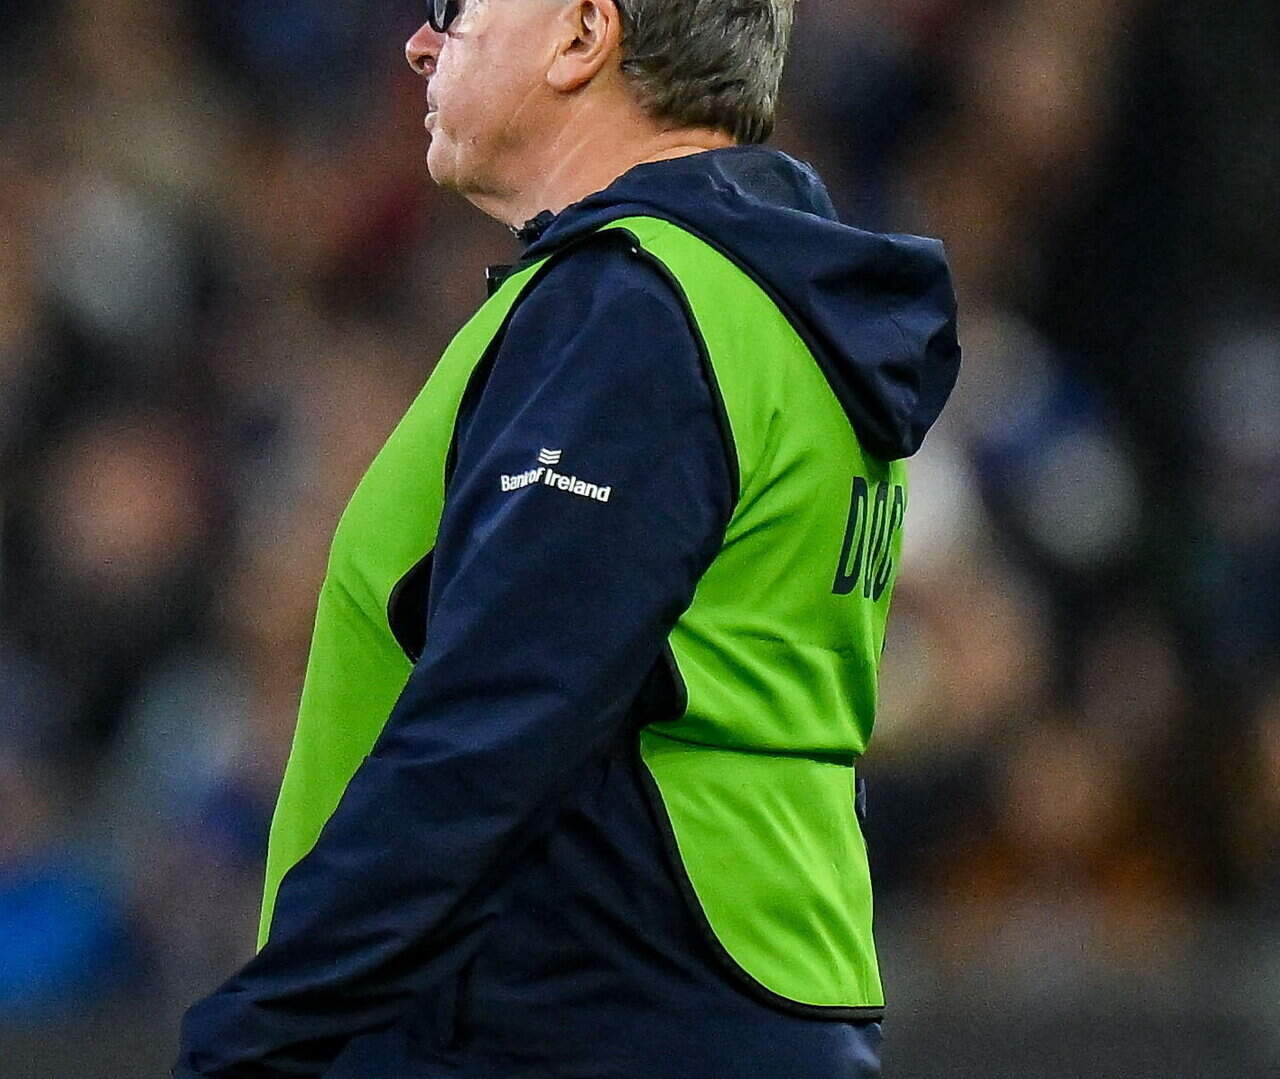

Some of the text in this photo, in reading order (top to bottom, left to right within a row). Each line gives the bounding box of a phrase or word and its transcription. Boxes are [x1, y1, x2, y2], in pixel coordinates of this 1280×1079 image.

[500, 467, 611, 502] Bank of Ireland
[831, 476, 905, 602] DOC
